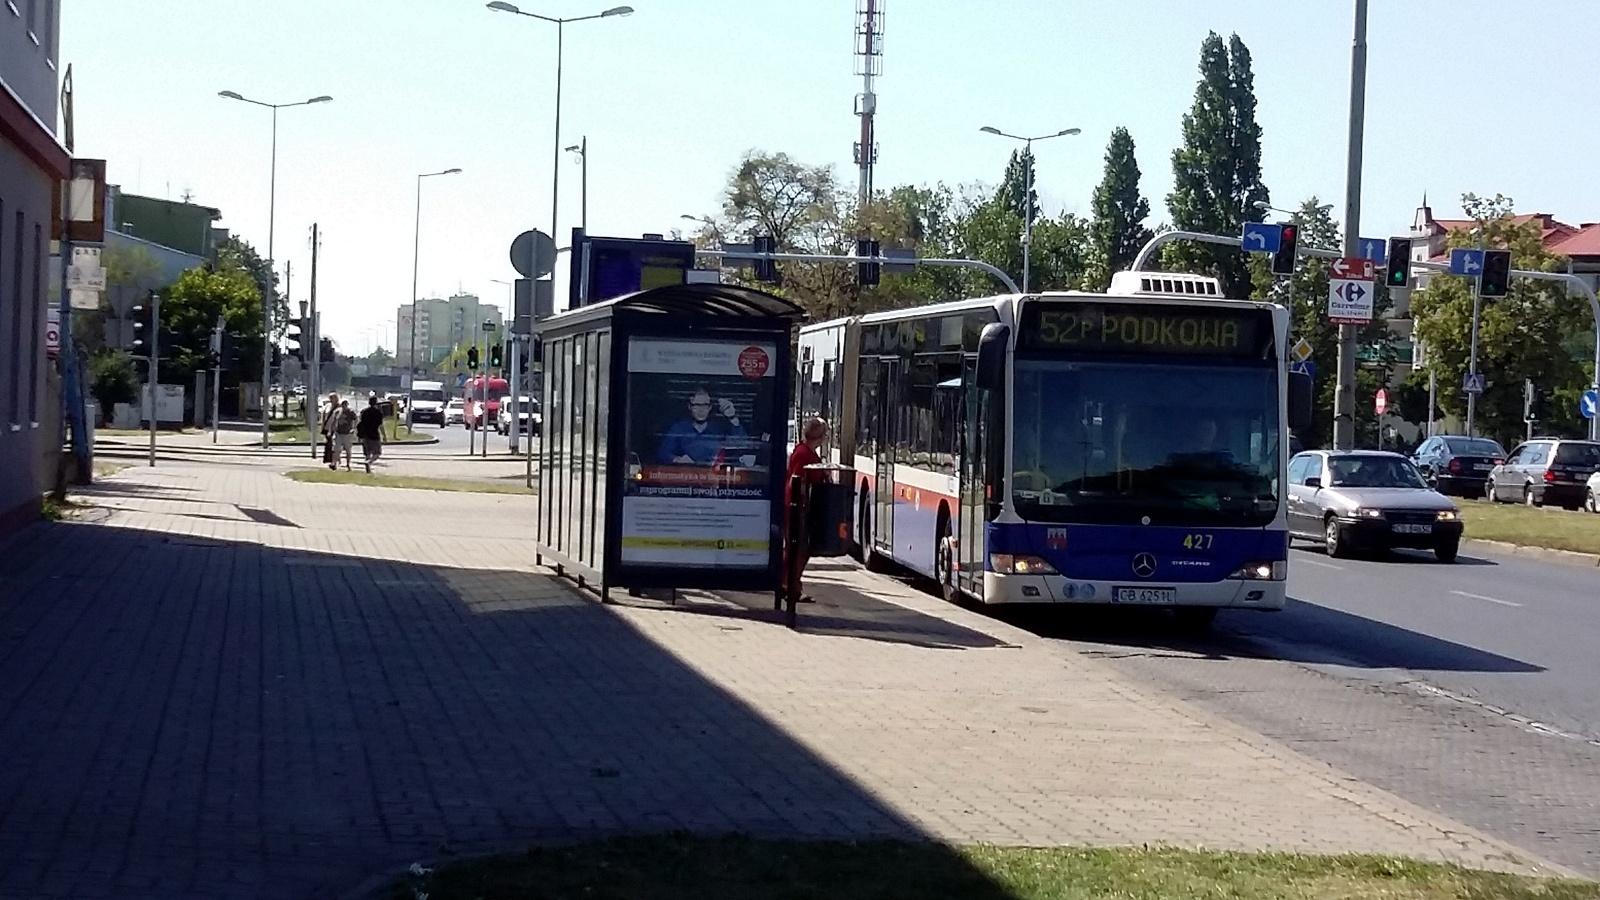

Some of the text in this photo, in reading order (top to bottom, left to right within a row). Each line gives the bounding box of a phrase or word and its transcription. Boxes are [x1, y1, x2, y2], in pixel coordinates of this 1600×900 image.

[1102, 312, 1238, 347] PODKOWA
[1183, 534, 1214, 550] 427
[1120, 589, 1173, 602] CB 6251L
